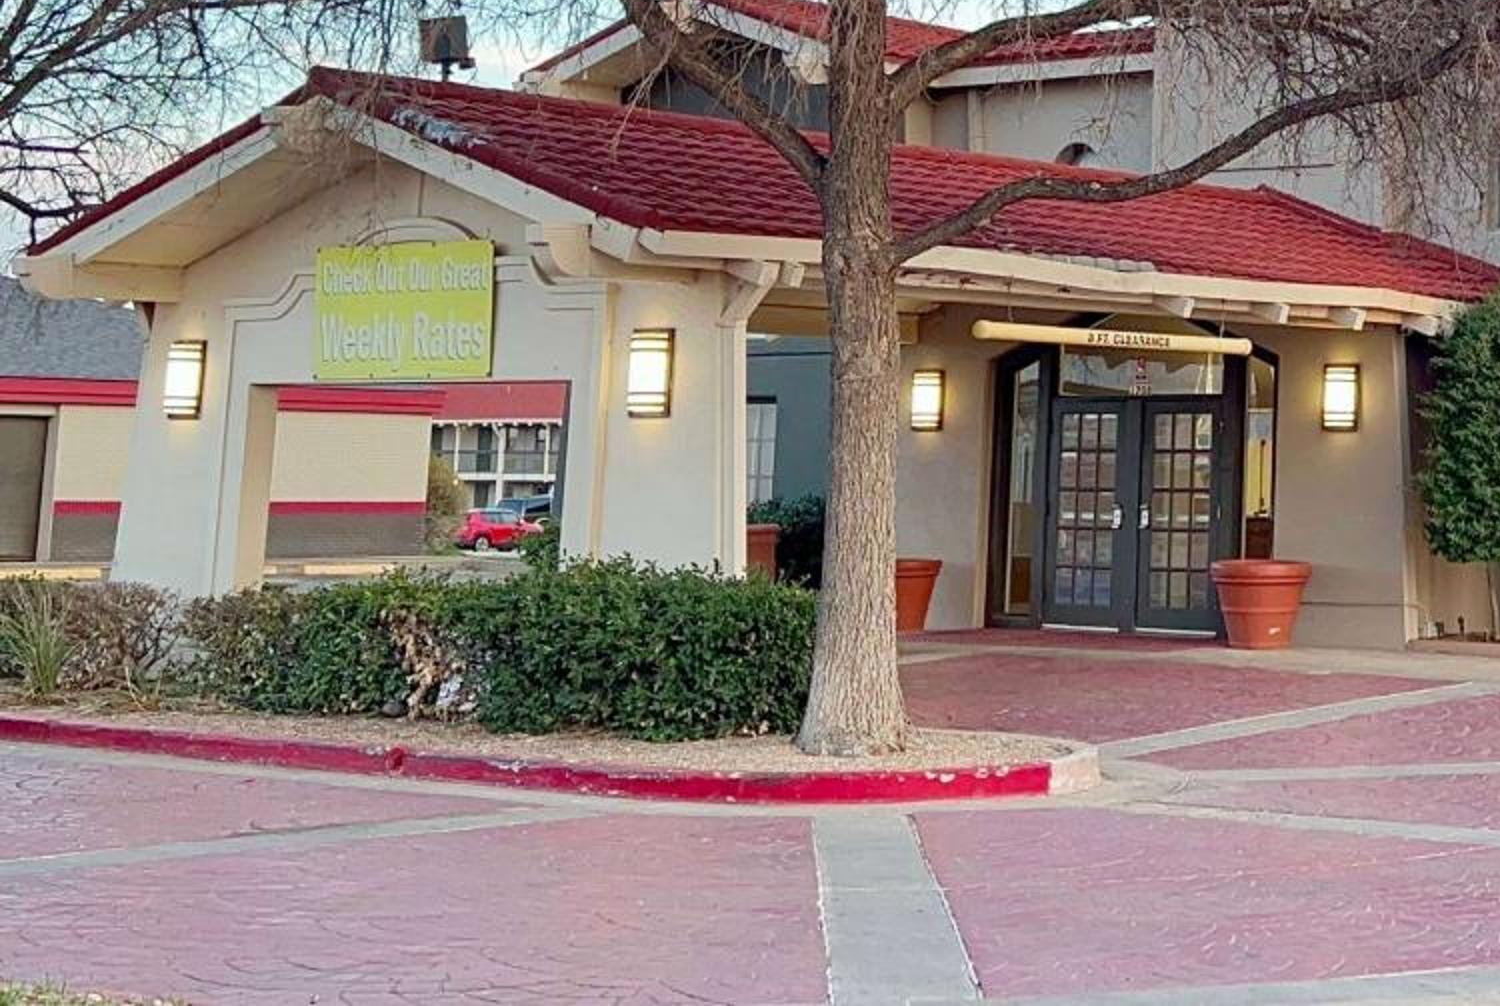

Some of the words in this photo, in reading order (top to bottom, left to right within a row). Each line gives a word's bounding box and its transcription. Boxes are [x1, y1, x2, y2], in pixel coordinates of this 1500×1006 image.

[323, 261, 371, 294] Check
[441, 257, 487, 290] Great
[321, 312, 402, 372] Weekly
[414, 310, 483, 361] Rates
